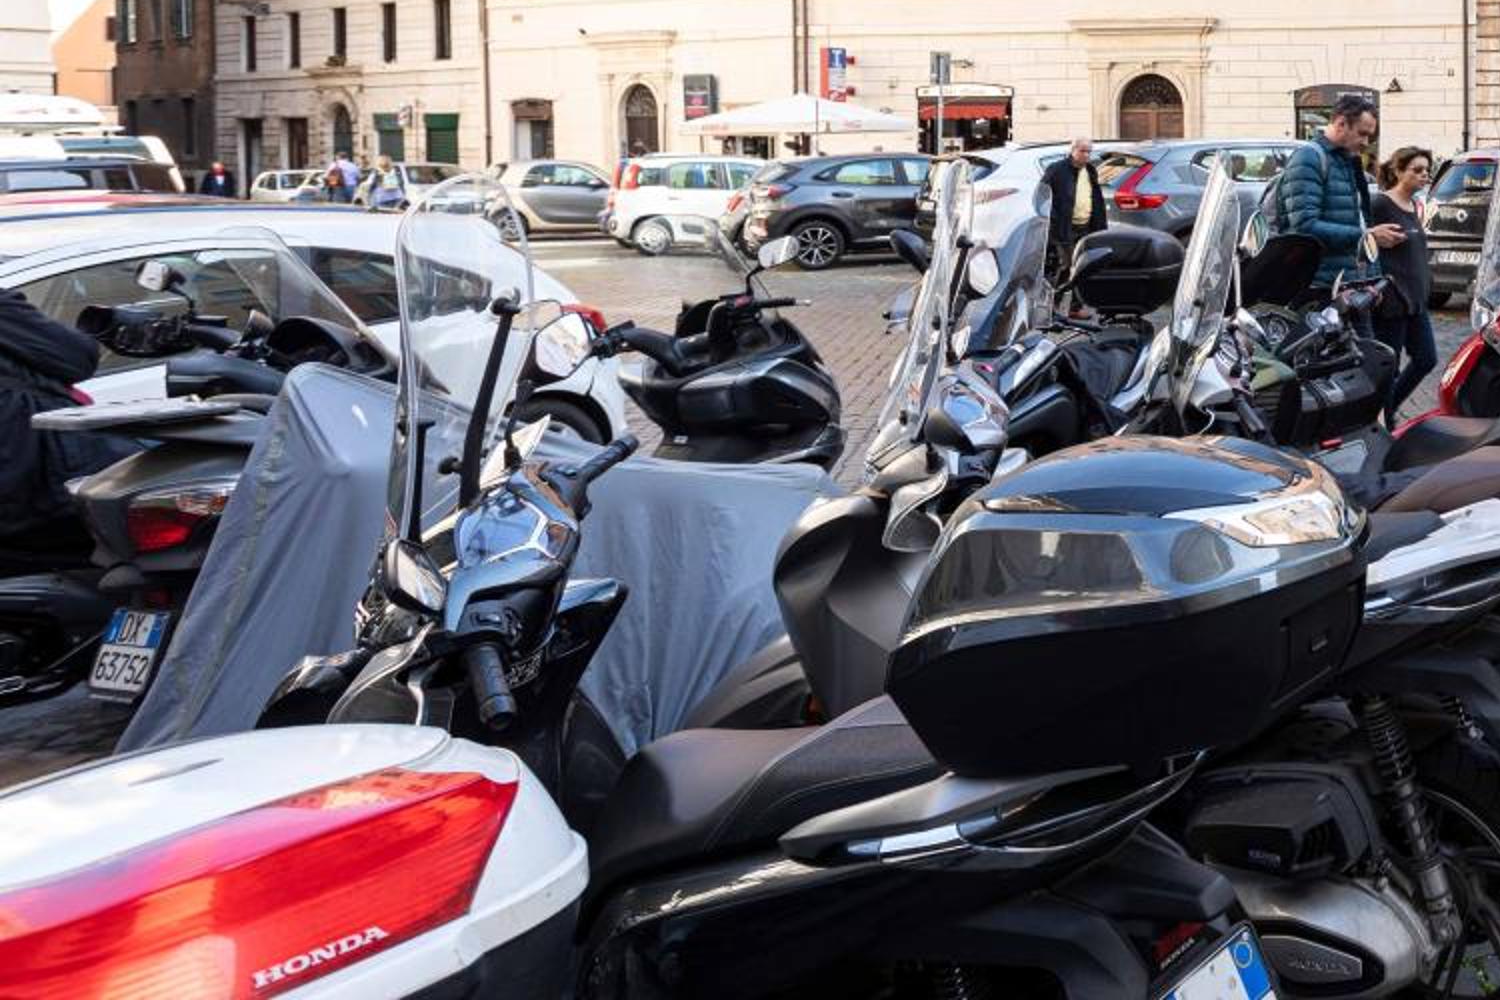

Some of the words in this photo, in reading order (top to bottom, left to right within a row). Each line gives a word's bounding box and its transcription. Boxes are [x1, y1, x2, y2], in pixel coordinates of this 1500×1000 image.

[118, 614, 146, 642] DX
[95, 651, 148, 685] 63752
[252, 926, 390, 988] HONDA
